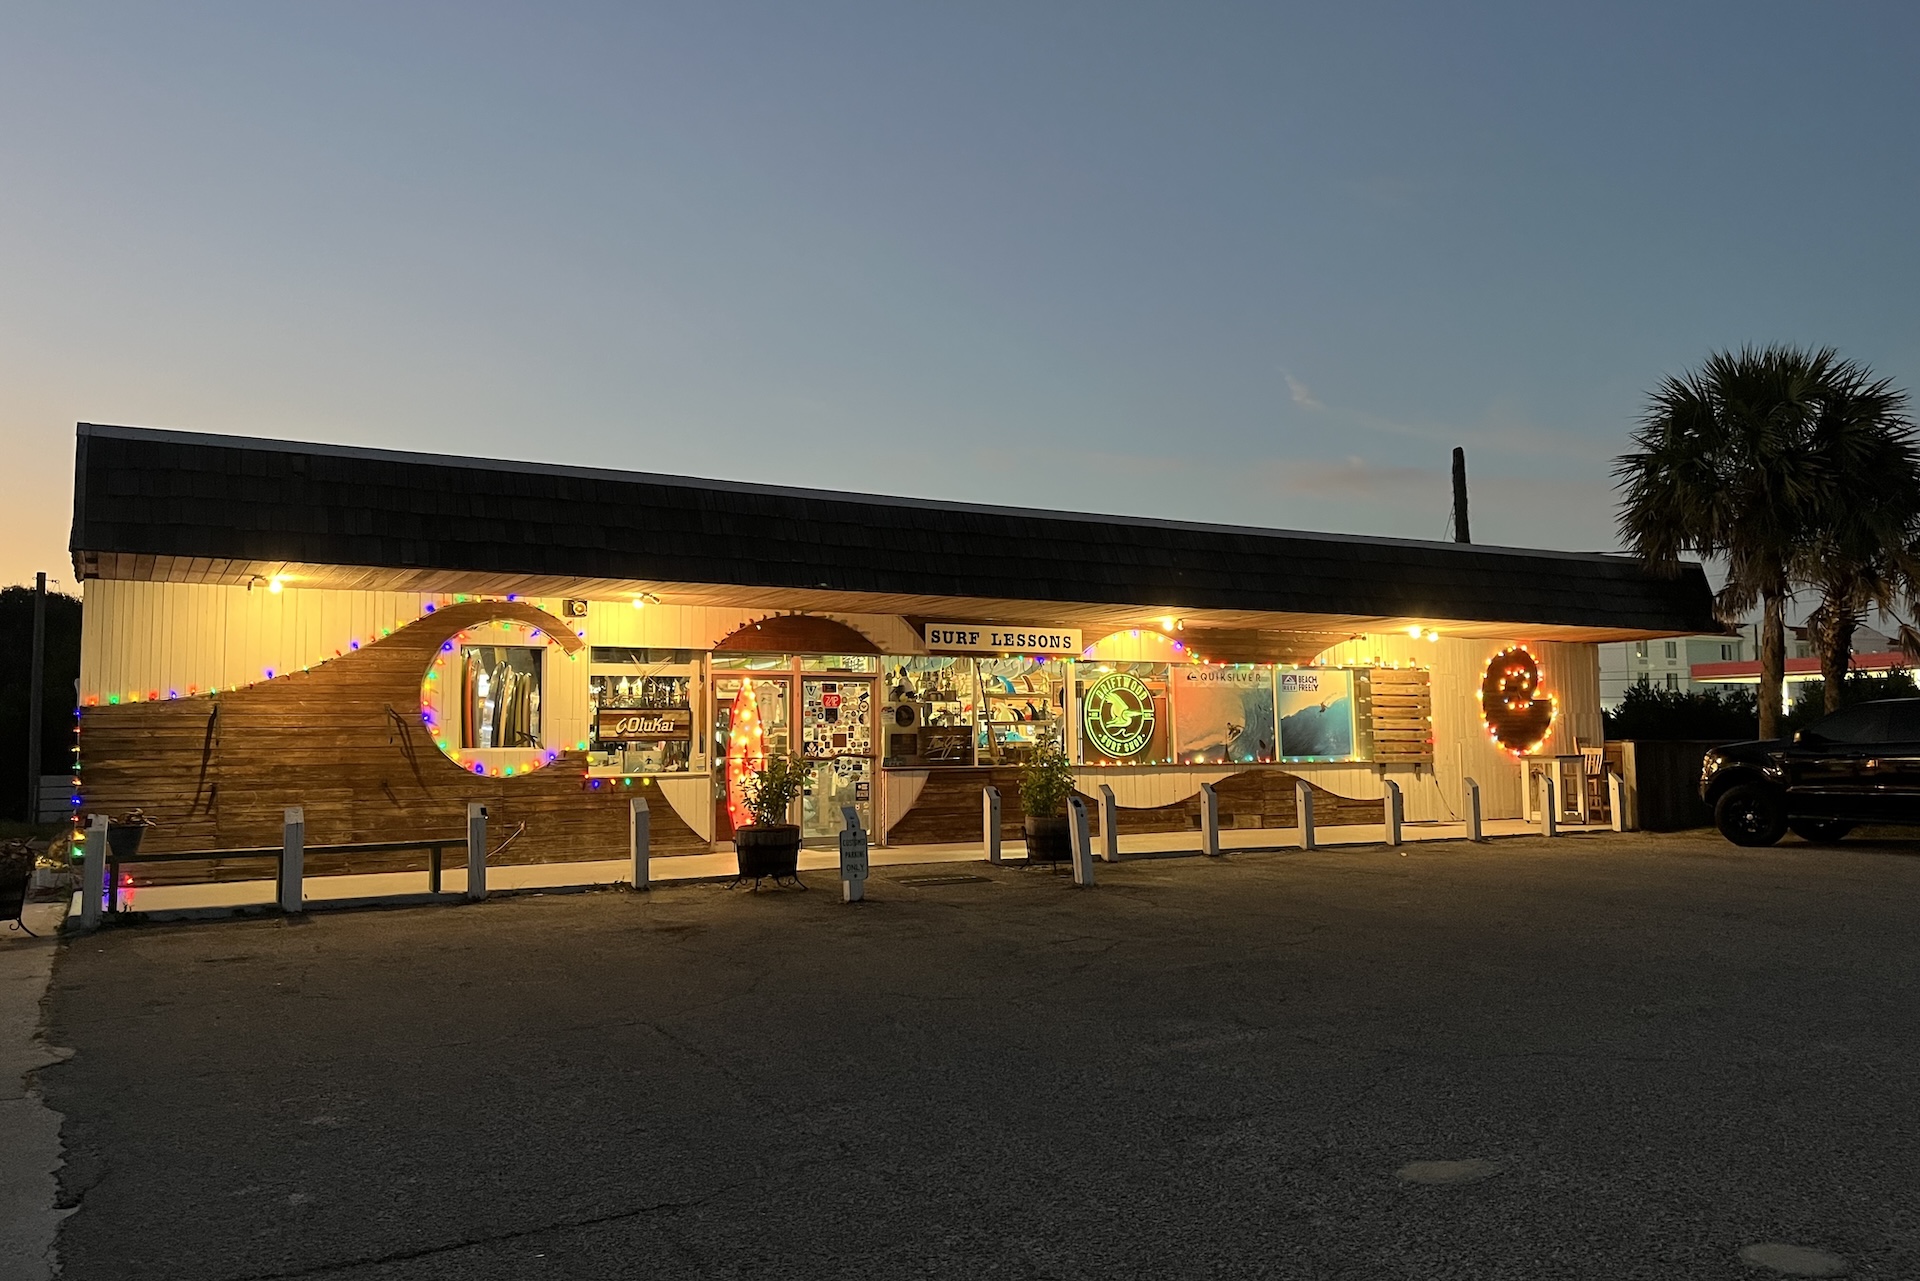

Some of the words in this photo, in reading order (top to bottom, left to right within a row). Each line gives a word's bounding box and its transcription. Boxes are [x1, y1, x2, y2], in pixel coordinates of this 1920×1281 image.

[931, 629, 980, 645] SURF
[991, 633, 1072, 648] LESSONS
[1200, 672, 1261, 682] QUIKSILVER
[1298, 675, 1318, 683] BEACH
[1095, 676, 1148, 700] DRIFTWOOD
[1298, 684, 1319, 692] FREELY
[627, 717, 675, 732] OluKai
[1100, 734, 1121, 752] SURF
[1124, 735, 1143, 752] SHOP
[846, 863, 864, 872] ONLY
